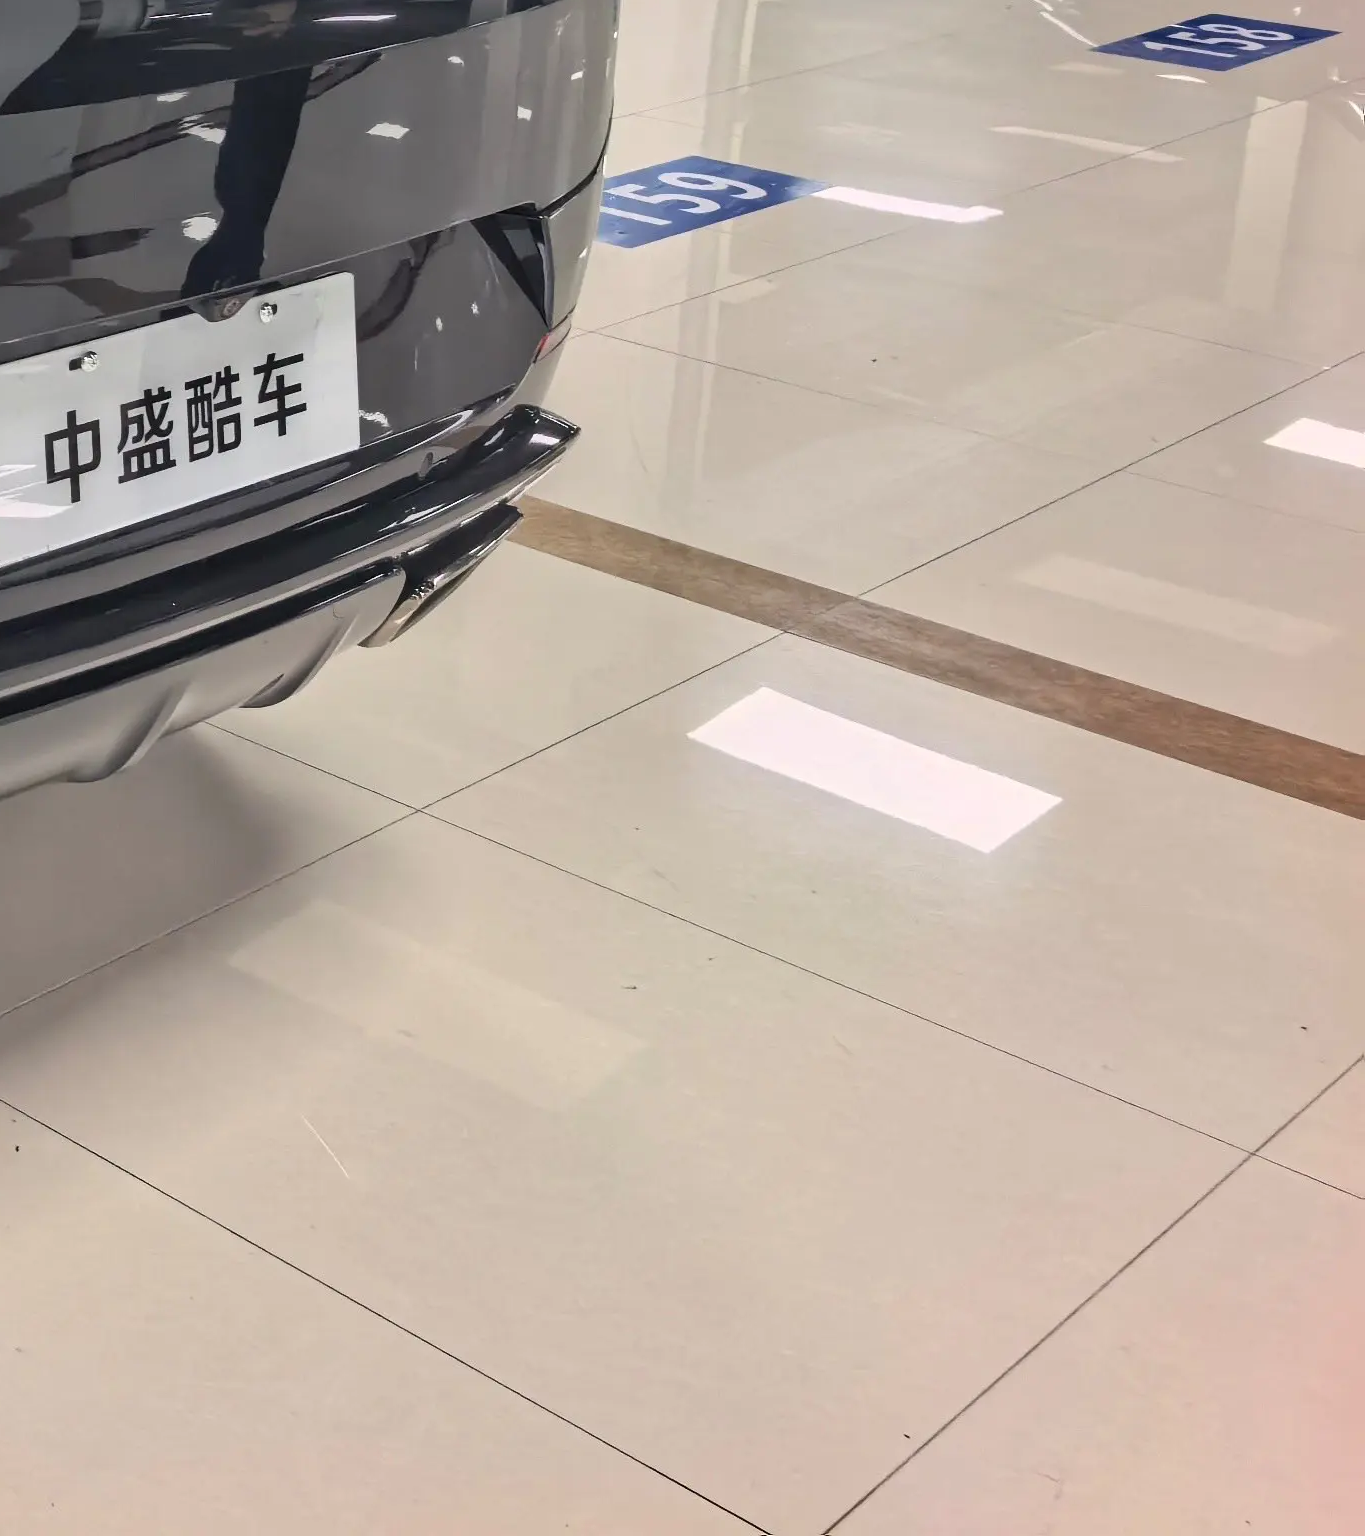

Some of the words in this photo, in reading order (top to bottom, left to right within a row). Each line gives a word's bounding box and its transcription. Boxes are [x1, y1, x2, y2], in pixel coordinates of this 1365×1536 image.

[1142, 23, 1295, 58] 158
[599, 171, 768, 226] 159
[43, 352, 309, 504] 中盛酷车
